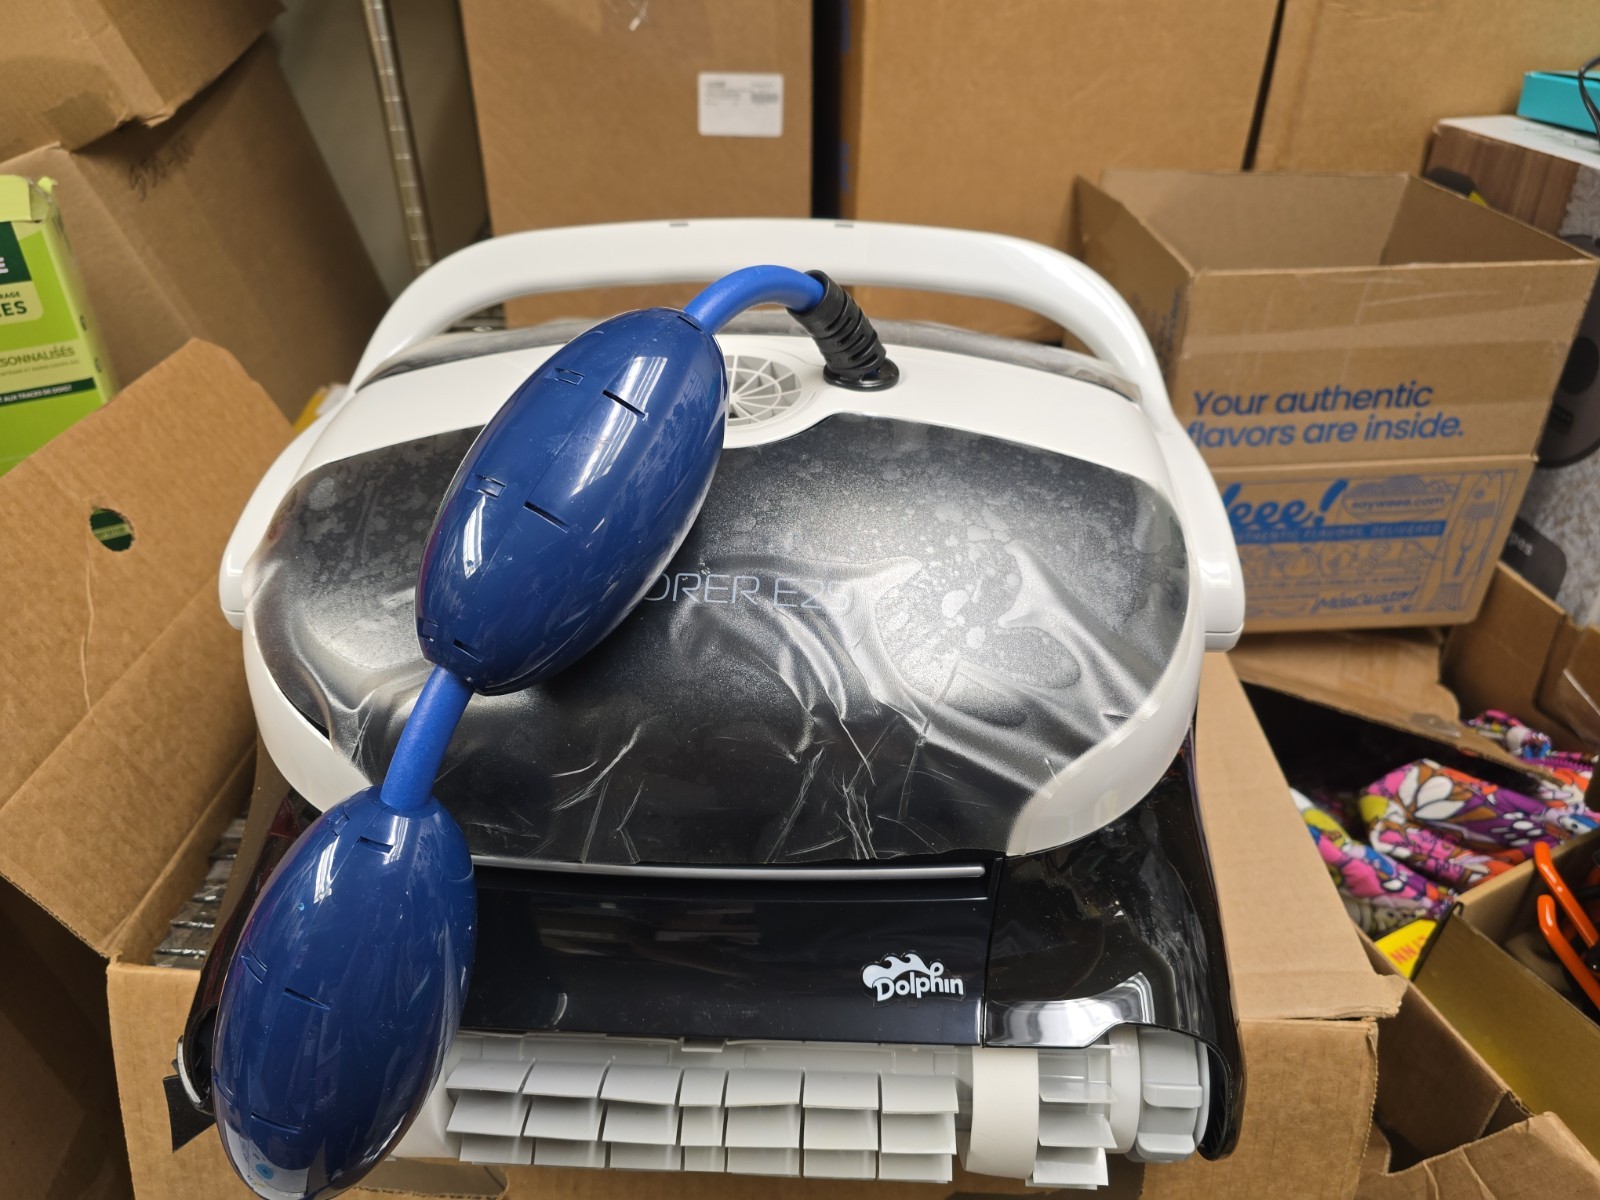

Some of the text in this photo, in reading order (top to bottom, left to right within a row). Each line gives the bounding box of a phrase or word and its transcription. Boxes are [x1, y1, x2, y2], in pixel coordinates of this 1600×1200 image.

[0, 300, 28, 317] ES
[1193, 380, 1434, 416] Your authentic
[1303, 423, 1356, 444] are
[1364, 412, 1464, 441] inside.
[872, 962, 964, 1002] Dolphin
